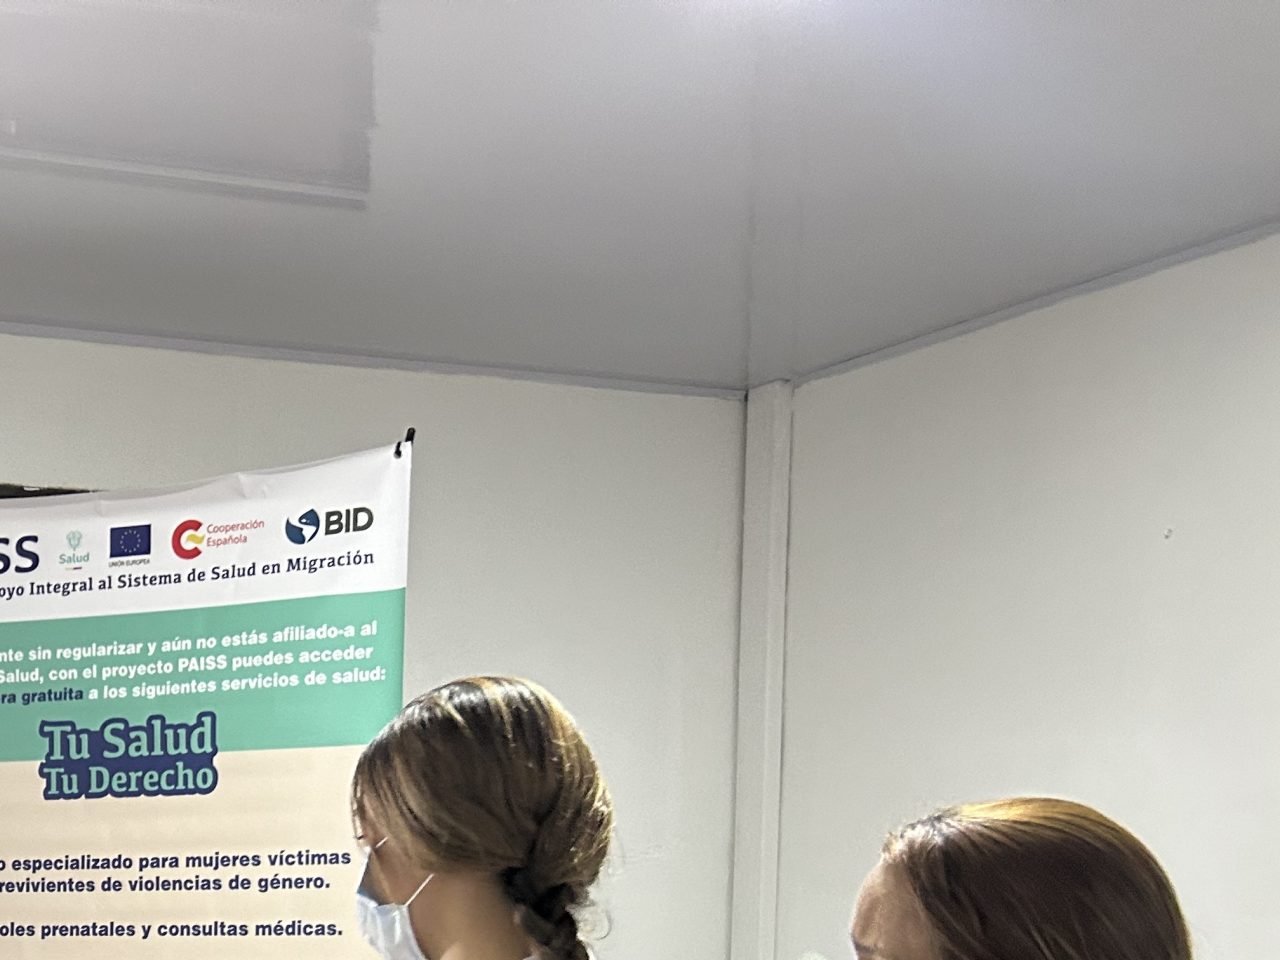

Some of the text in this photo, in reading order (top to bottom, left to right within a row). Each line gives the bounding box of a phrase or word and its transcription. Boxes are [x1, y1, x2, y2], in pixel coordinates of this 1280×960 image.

[207, 519, 265, 534] Cooperación
[324, 506, 374, 536] BID
[207, 534, 248, 548] Española
[29, 577, 93, 596] Integral
[98, 576, 112, 590] al
[118, 573, 181, 589] Sistema
[187, 568, 206, 583] de
[211, 563, 256, 580] Salud
[262, 561, 281, 575] en
[286, 550, 375, 573] Migración
[59, 553, 90, 565] Salud
[29, 646, 52, 661] sin
[56, 641, 143, 659] regularizar
[148, 642, 157, 656] y
[161, 636, 192, 652] aún
[196, 638, 217, 650] no
[222, 629, 268, 647] estás
[272, 624, 355, 643] afiliado-a
[360, 620, 377, 636] al
[48, 668, 78, 681] con
[82, 665, 97, 679] el
[102, 660, 173, 680] proyecto
[178, 654, 227, 672] PAISS
[232, 651, 294, 670] puedes
[299, 645, 374, 664] acceder
[21, 687, 84, 706] gratuita
[88, 689, 98, 700] a
[103, 685, 127, 699] los
[132, 678, 216, 699] siguientes
[221, 670, 300, 692] servicios
[304, 670, 327, 685] de
[332, 665, 386, 684] salud:
[43, 715, 214, 761] Tu Salud
[43, 761, 214, 795] Tu Derecho
[11, 854, 133, 874] especializado
[139, 856, 179, 872] para
[185, 851, 261, 871] mujeres
[268, 849, 352, 866] víctimas
[100, 876, 123, 892] de
[128, 875, 222, 892] violencias
[228, 874, 251, 890] de
[257, 873, 331, 893] género.
[40, 921, 136, 940] prenatales
[141, 924, 152, 940] y
[157, 920, 249, 937] consultas
[254, 919, 343, 937] médicas.
